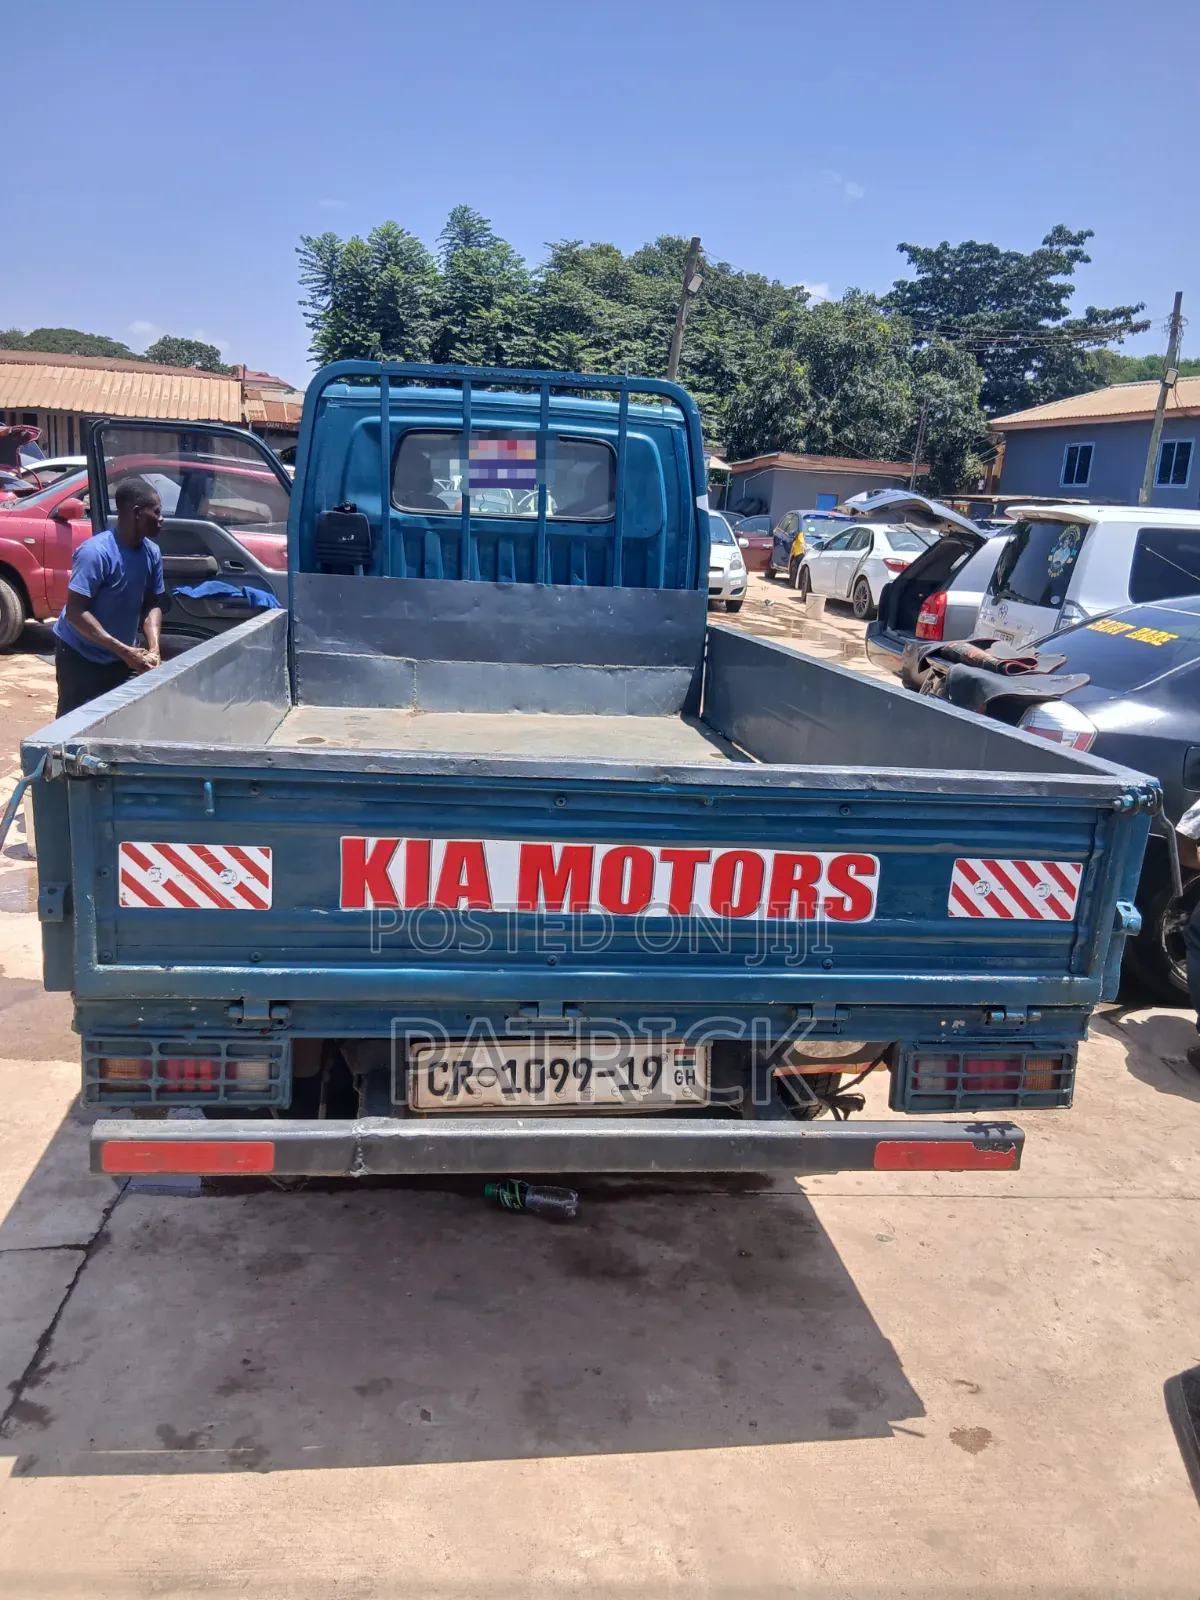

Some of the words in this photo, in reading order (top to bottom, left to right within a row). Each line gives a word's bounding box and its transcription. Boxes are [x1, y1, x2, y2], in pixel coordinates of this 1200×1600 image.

[341, 838, 493, 910] KIA
[516, 842, 877, 922] MOTORS
[427, 1060, 475, 1097] CR
[674, 1069, 696, 1086] GH
